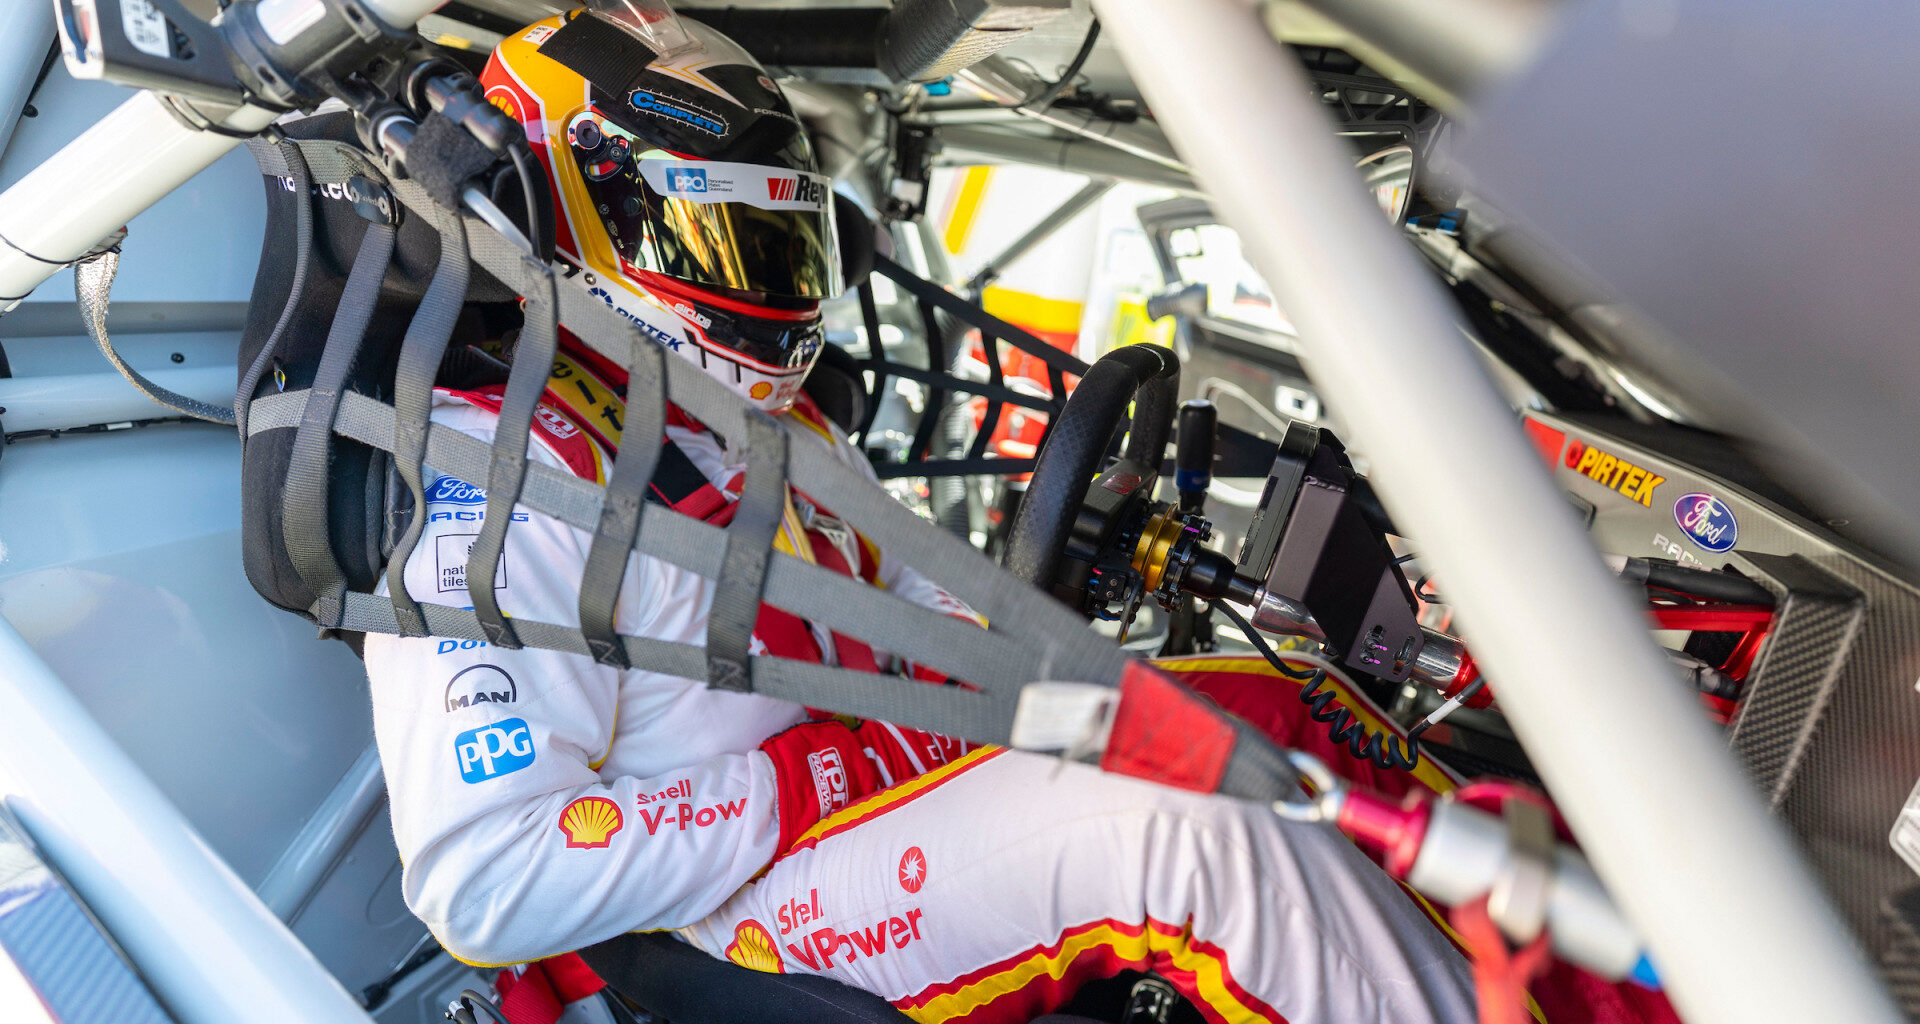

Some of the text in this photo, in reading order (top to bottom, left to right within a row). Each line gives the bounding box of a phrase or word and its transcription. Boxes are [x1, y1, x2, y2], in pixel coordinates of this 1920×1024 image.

[632, 92, 723, 133] COMPLETE
[675, 175, 706, 191] PPQ
[795, 173, 826, 209] Rep
[436, 478, 488, 500] For
[1576, 446, 1667, 508] PIRTEK
[425, 510, 529, 524] ACIG
[1684, 499, 1728, 545] Ford
[449, 691, 511, 712] MAN
[458, 726, 532, 776] PPG
[638, 798, 748, 836] V-Pow
